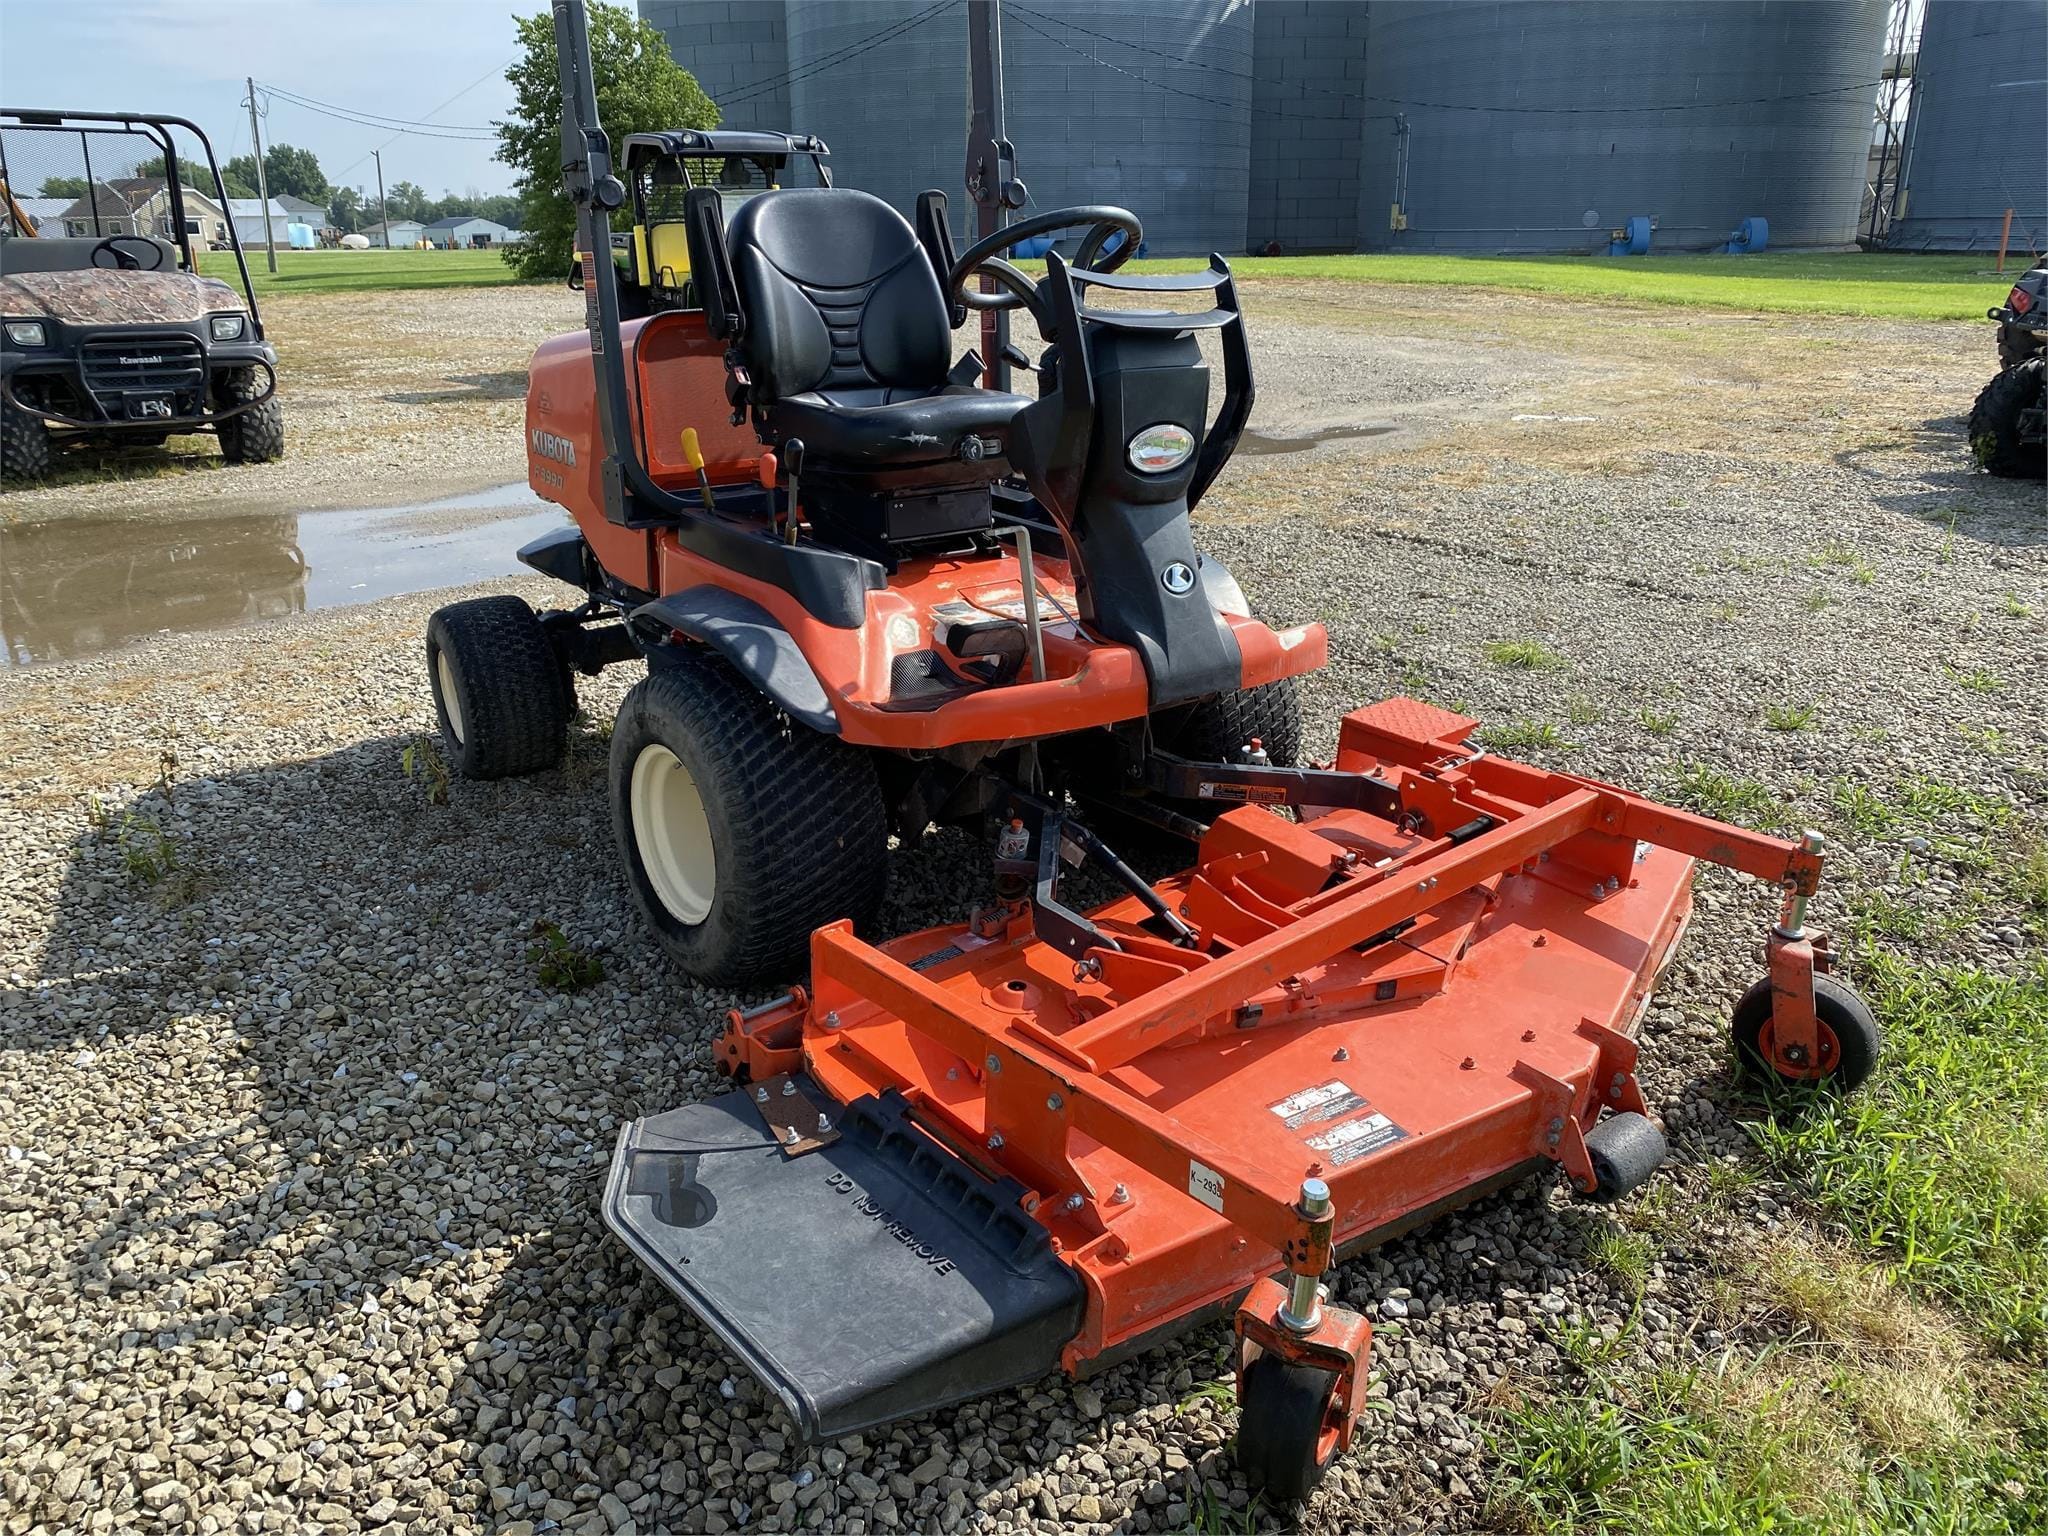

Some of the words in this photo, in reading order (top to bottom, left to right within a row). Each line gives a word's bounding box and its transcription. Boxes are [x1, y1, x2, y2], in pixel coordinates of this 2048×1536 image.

[120, 355, 162, 364] Kawasaki
[532, 428, 577, 467] KUBOTA
[825, 1171, 855, 1194] DO
[852, 1193, 892, 1221] NOT
[883, 1220, 957, 1276] REMOVE
